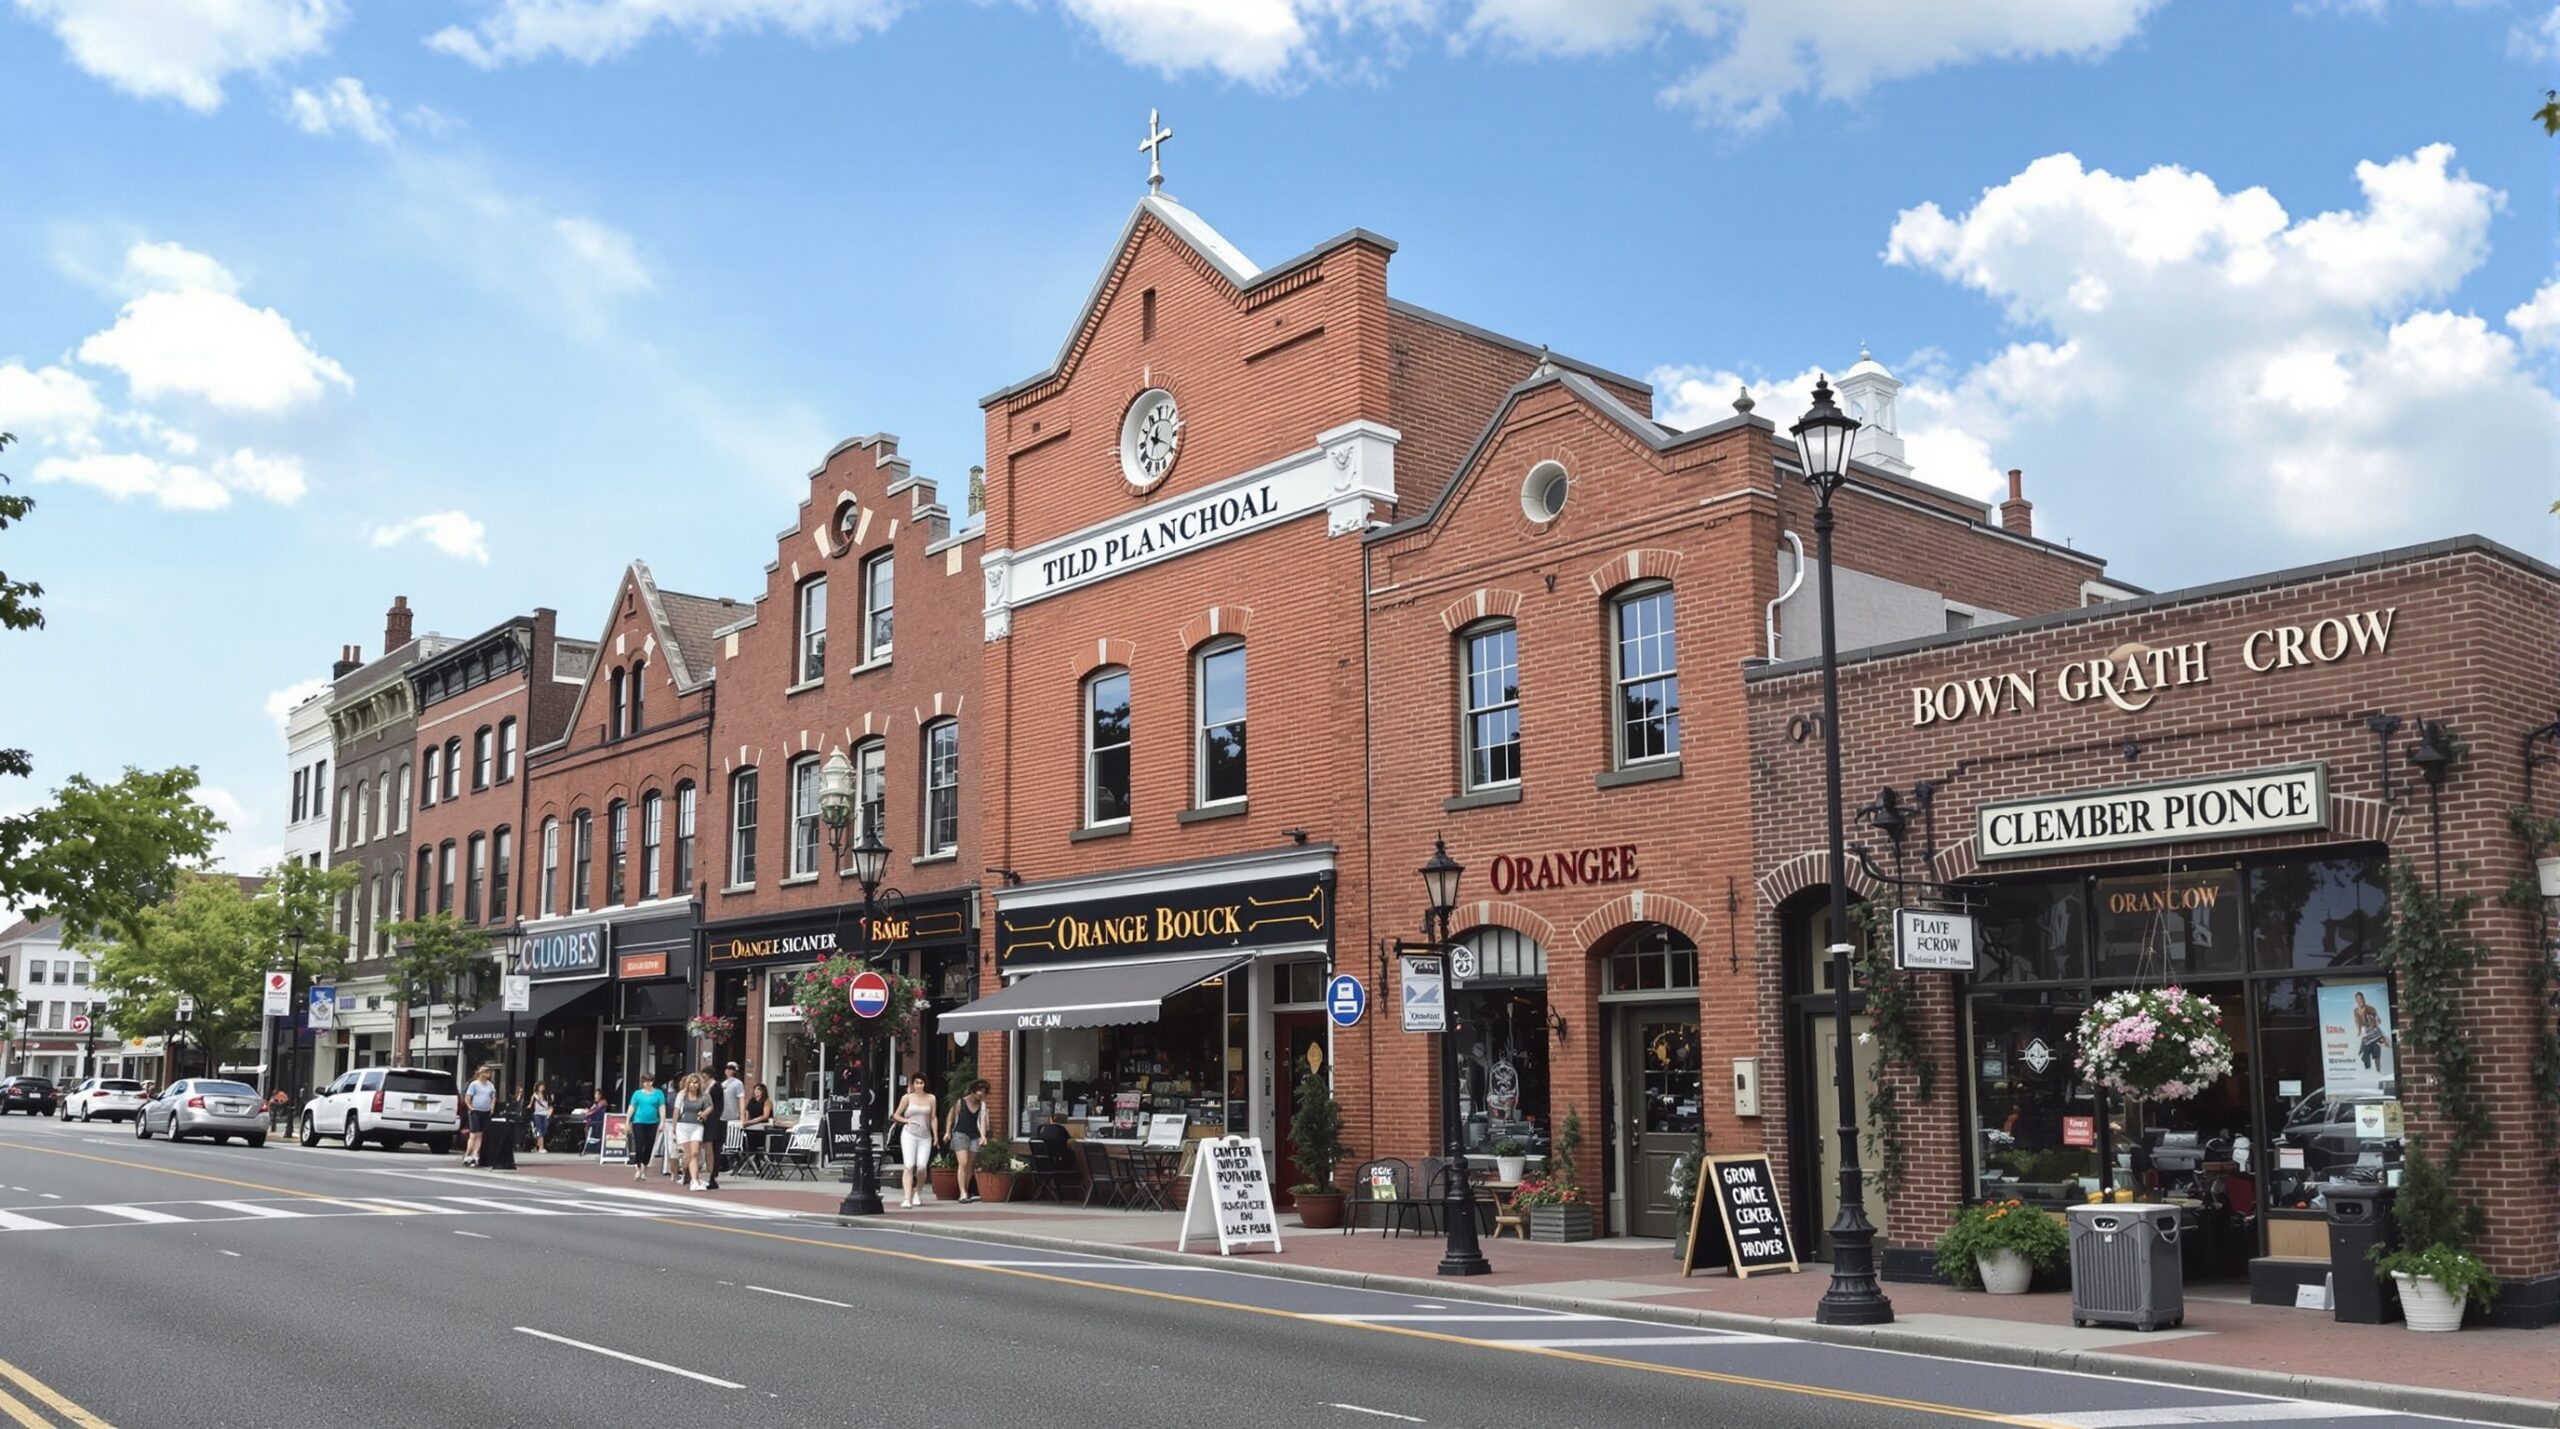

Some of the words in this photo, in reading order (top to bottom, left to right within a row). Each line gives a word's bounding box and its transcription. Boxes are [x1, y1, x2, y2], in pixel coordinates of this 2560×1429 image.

[1043, 547, 1097, 586] TILD
[1911, 669, 2037, 726] BOWN
[2057, 641, 2210, 712] GRATH
[2243, 607, 2396, 672] CROW
[1989, 798, 2154, 848] CLEMBER
[2164, 780, 2310, 831] PIONCE
[1490, 843, 1640, 895] ORANGEE
[1057, 914, 1149, 950] ORANGE
[1156, 905, 1242, 942] BOUCK
